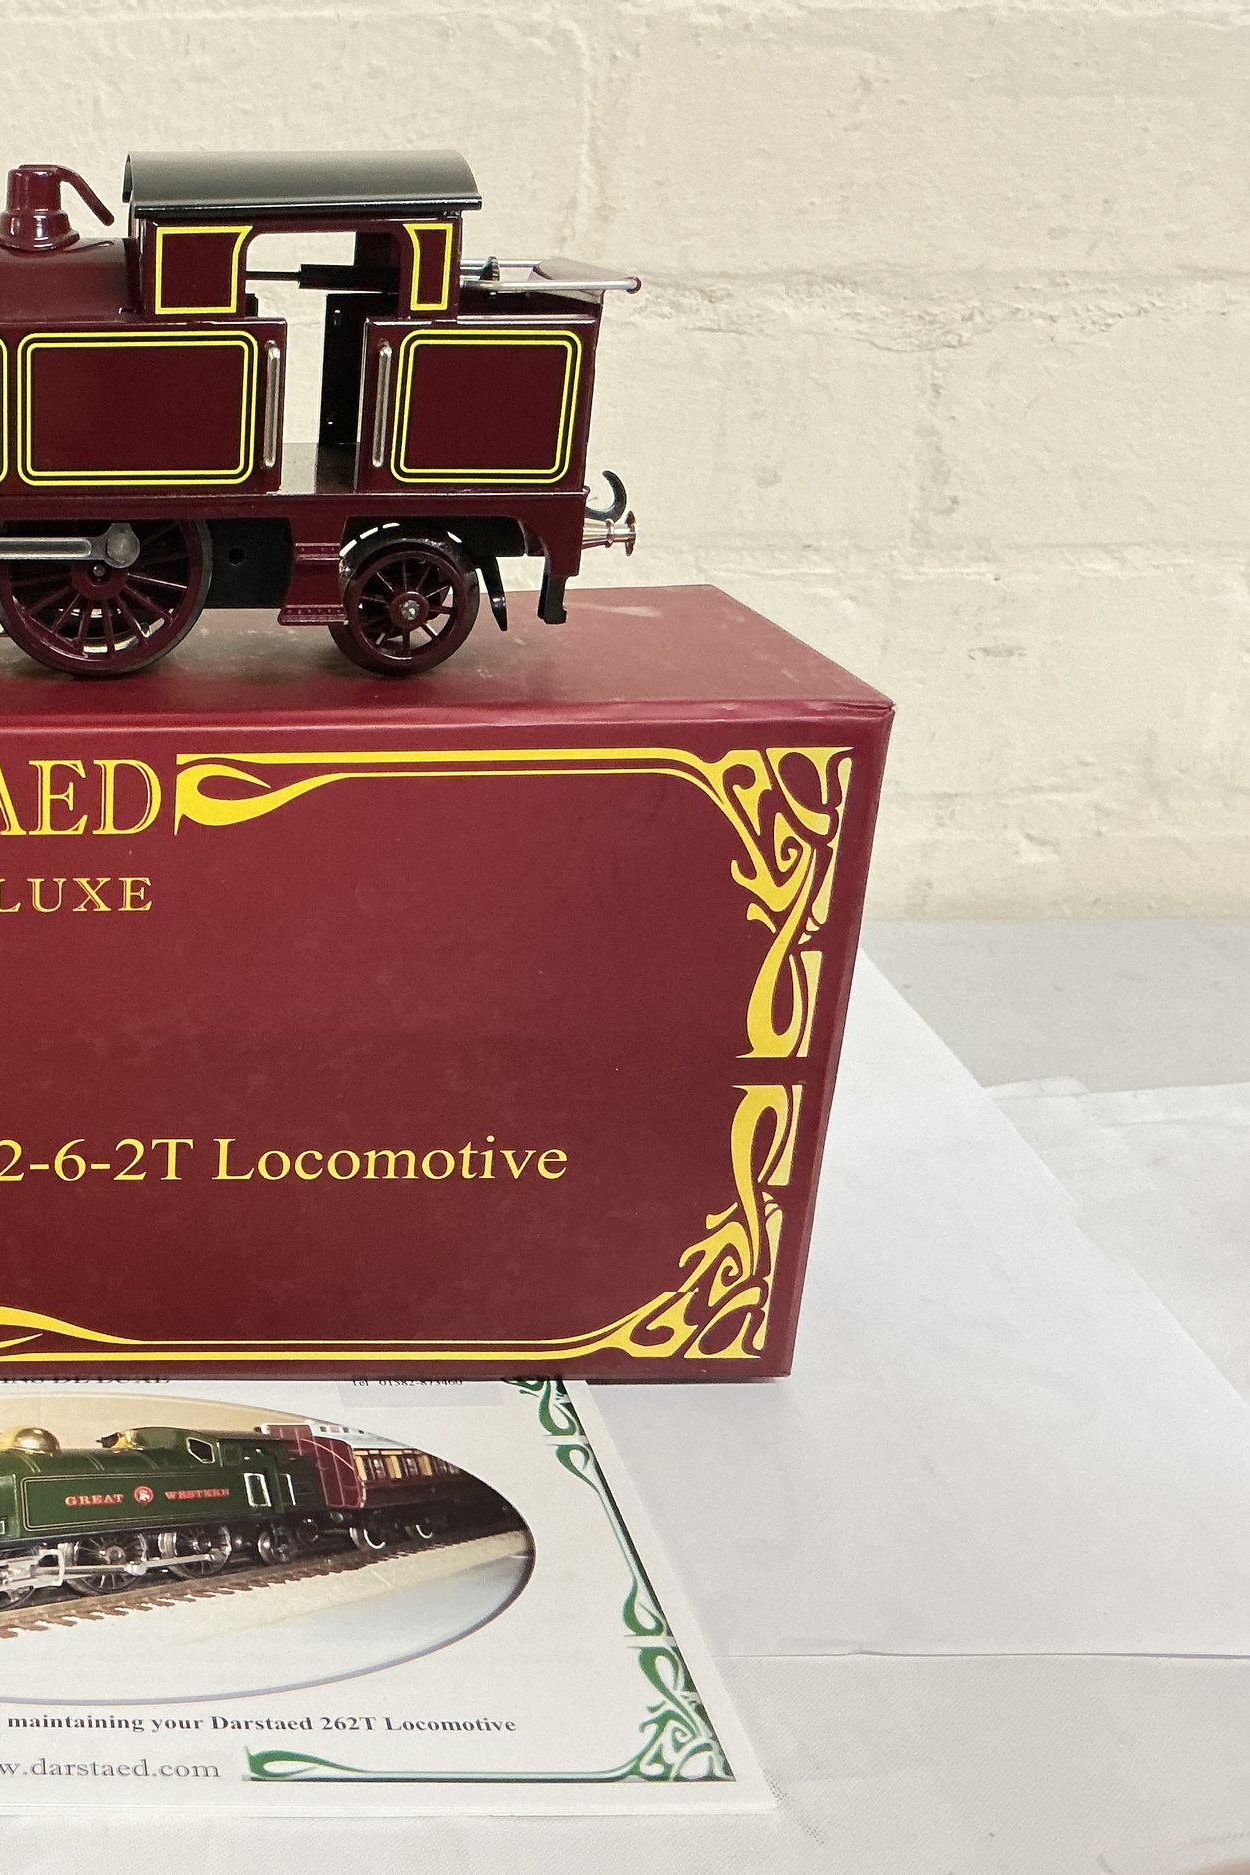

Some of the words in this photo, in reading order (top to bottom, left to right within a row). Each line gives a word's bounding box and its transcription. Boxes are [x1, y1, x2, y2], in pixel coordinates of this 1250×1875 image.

[211, 1134, 569, 1182] Locomotive
[65, 1493, 125, 1507] GREAT
[164, 1488, 230, 1501] WESTERN
[7, 1714, 145, 1732] maintaining
[150, 1718, 204, 1732] your
[211, 1715, 313, 1731] Darstaed
[321, 1716, 376, 1732] 262T
[385, 1716, 517, 1733] Locomotive
